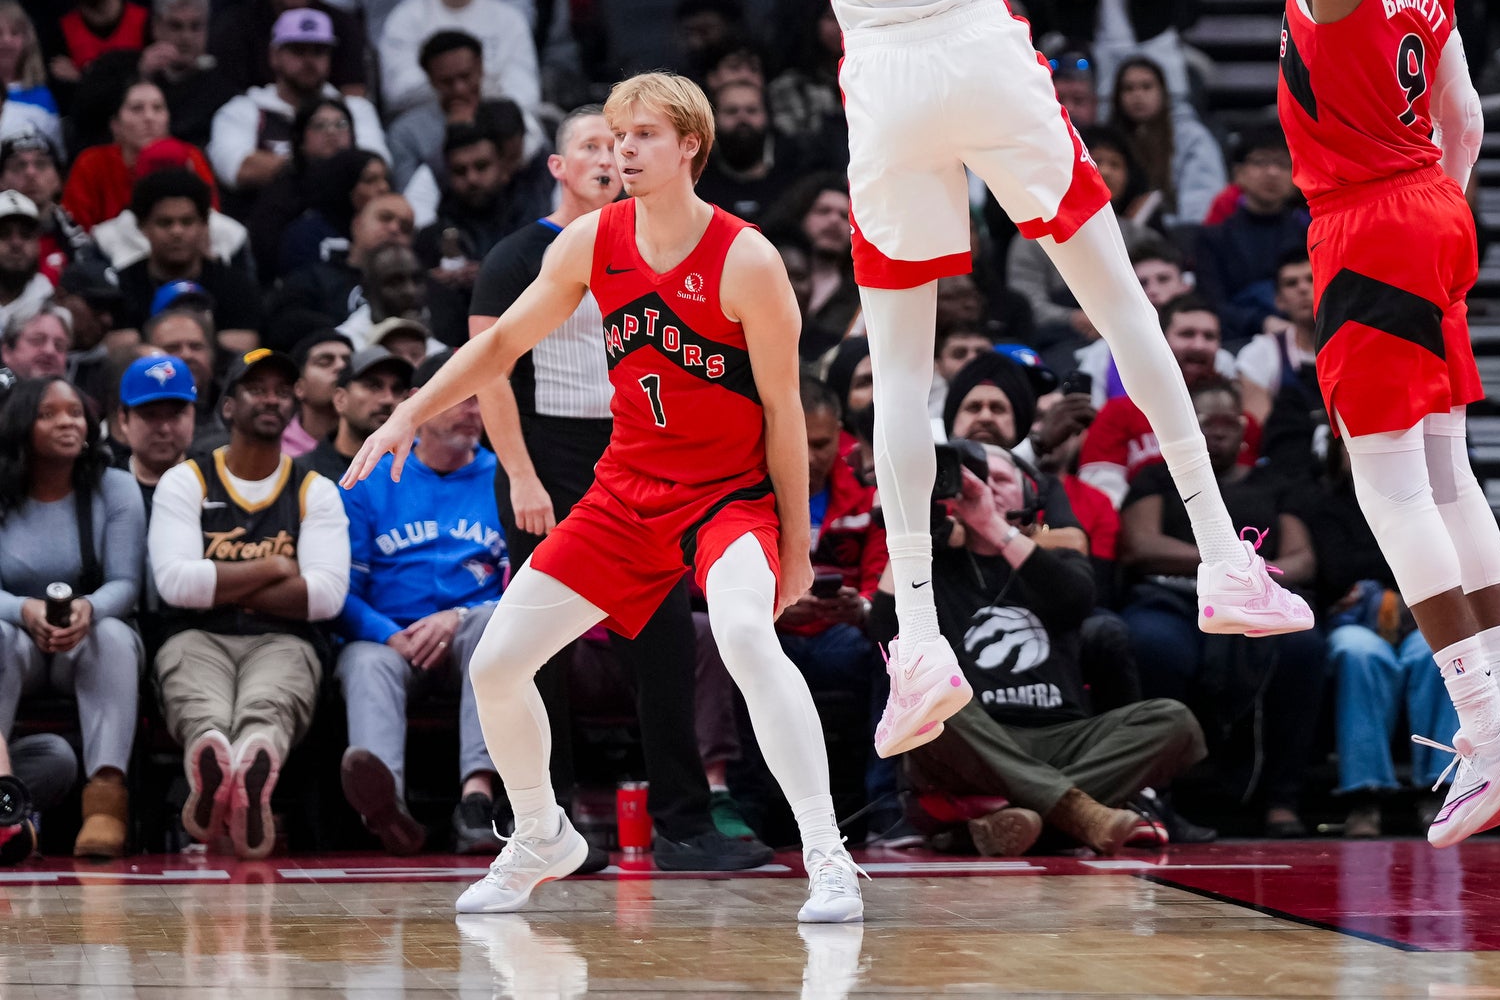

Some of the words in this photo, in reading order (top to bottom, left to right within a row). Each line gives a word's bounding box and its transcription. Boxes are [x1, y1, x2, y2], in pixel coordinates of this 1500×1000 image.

[1396, 32, 1427, 127] 9
[676, 290, 692, 300] Sun
[692, 294, 707, 303] Life
[603, 307, 726, 379] RAPTORS
[637, 373, 667, 429] 1
[203, 526, 295, 560] Toronto
[375, 520, 440, 556] BLUE
